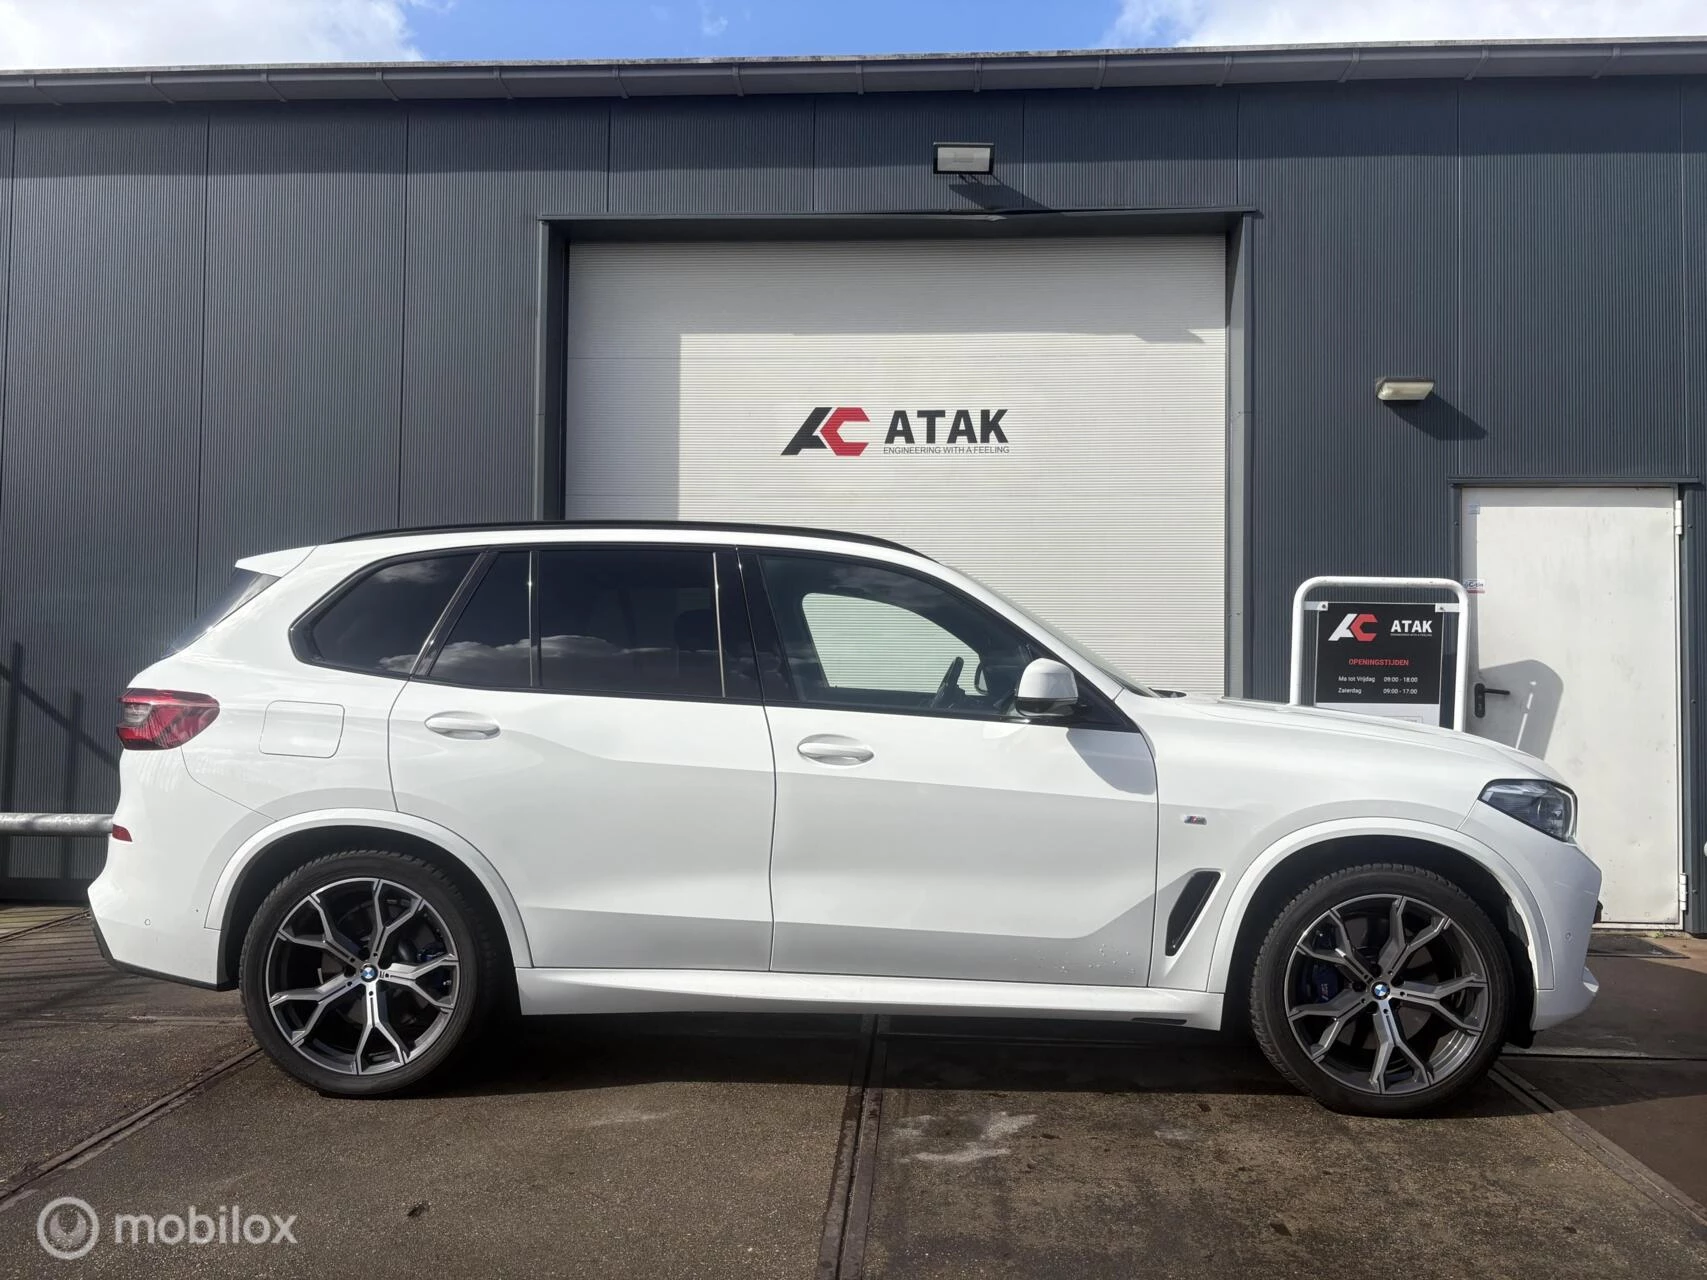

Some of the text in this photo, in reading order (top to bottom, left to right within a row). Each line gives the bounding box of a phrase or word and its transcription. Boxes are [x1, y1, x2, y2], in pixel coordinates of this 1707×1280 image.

[884, 409, 1009, 444] ATAK
[883, 446, 1010, 454] ENGINEERING WITH A FEELING
[1390, 620, 1433, 633] ATAK
[1348, 658, 1409, 666] OPENINGSTIJDEN
